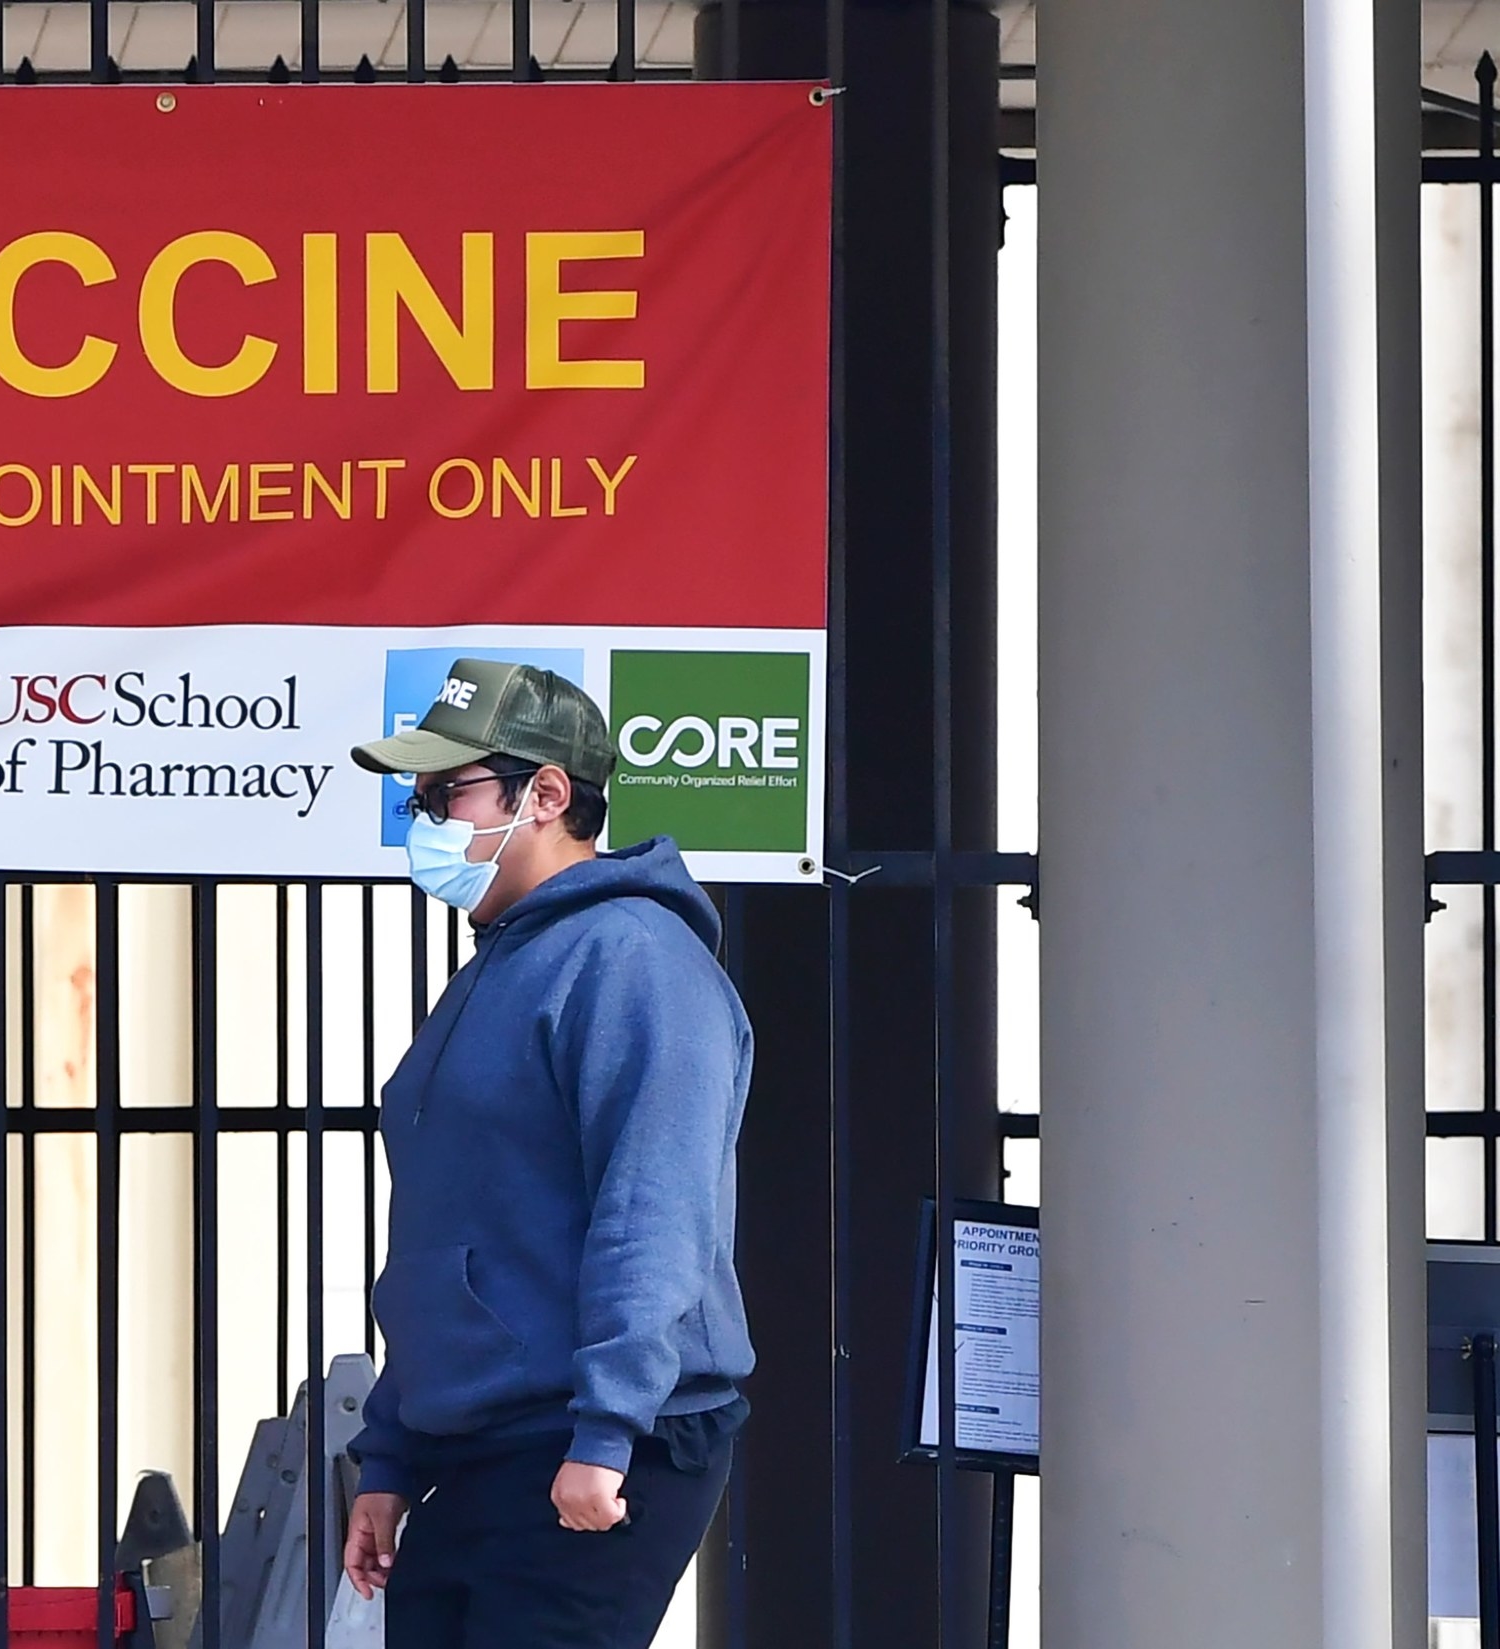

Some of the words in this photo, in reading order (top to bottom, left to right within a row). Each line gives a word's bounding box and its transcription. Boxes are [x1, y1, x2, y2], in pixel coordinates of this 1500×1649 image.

[427, 455, 638, 519] ONLY
[112, 671, 301, 730] School
[618, 715, 799, 769] CORE
[47, 738, 334, 818] Pharmacy
[618, 773, 679, 788] Community
[681, 774, 735, 788] Organized
[738, 775, 766, 787] Relief
[768, 775, 797, 787] Effort
[954, 1239, 1005, 1254] RIORITY
